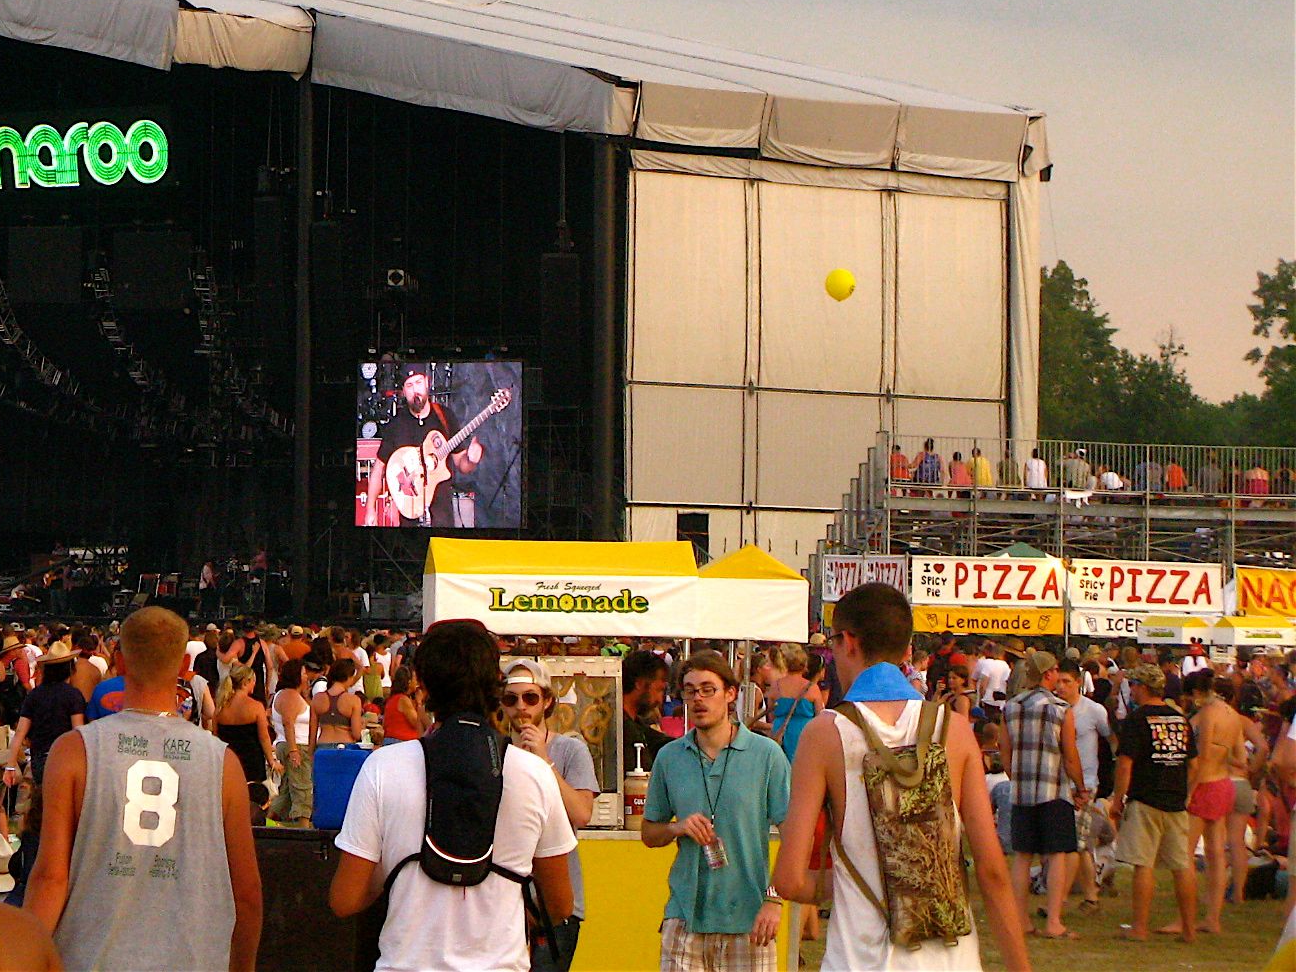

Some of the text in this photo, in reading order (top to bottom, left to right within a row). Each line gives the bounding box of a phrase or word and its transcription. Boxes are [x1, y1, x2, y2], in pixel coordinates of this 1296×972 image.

[923, 563, 931, 573] I
[535, 581, 602, 593] Fresh Squeezed
[955, 562, 1059, 600] PIZZA
[1109, 566, 1211, 605] PIZZA
[489, 587, 649, 613] Lemonade
[946, 614, 1031, 629] Lemonade
[118, 746, 149, 757] Saloon
[163, 738, 192, 753] KARZ
[123, 759, 179, 847] 8
